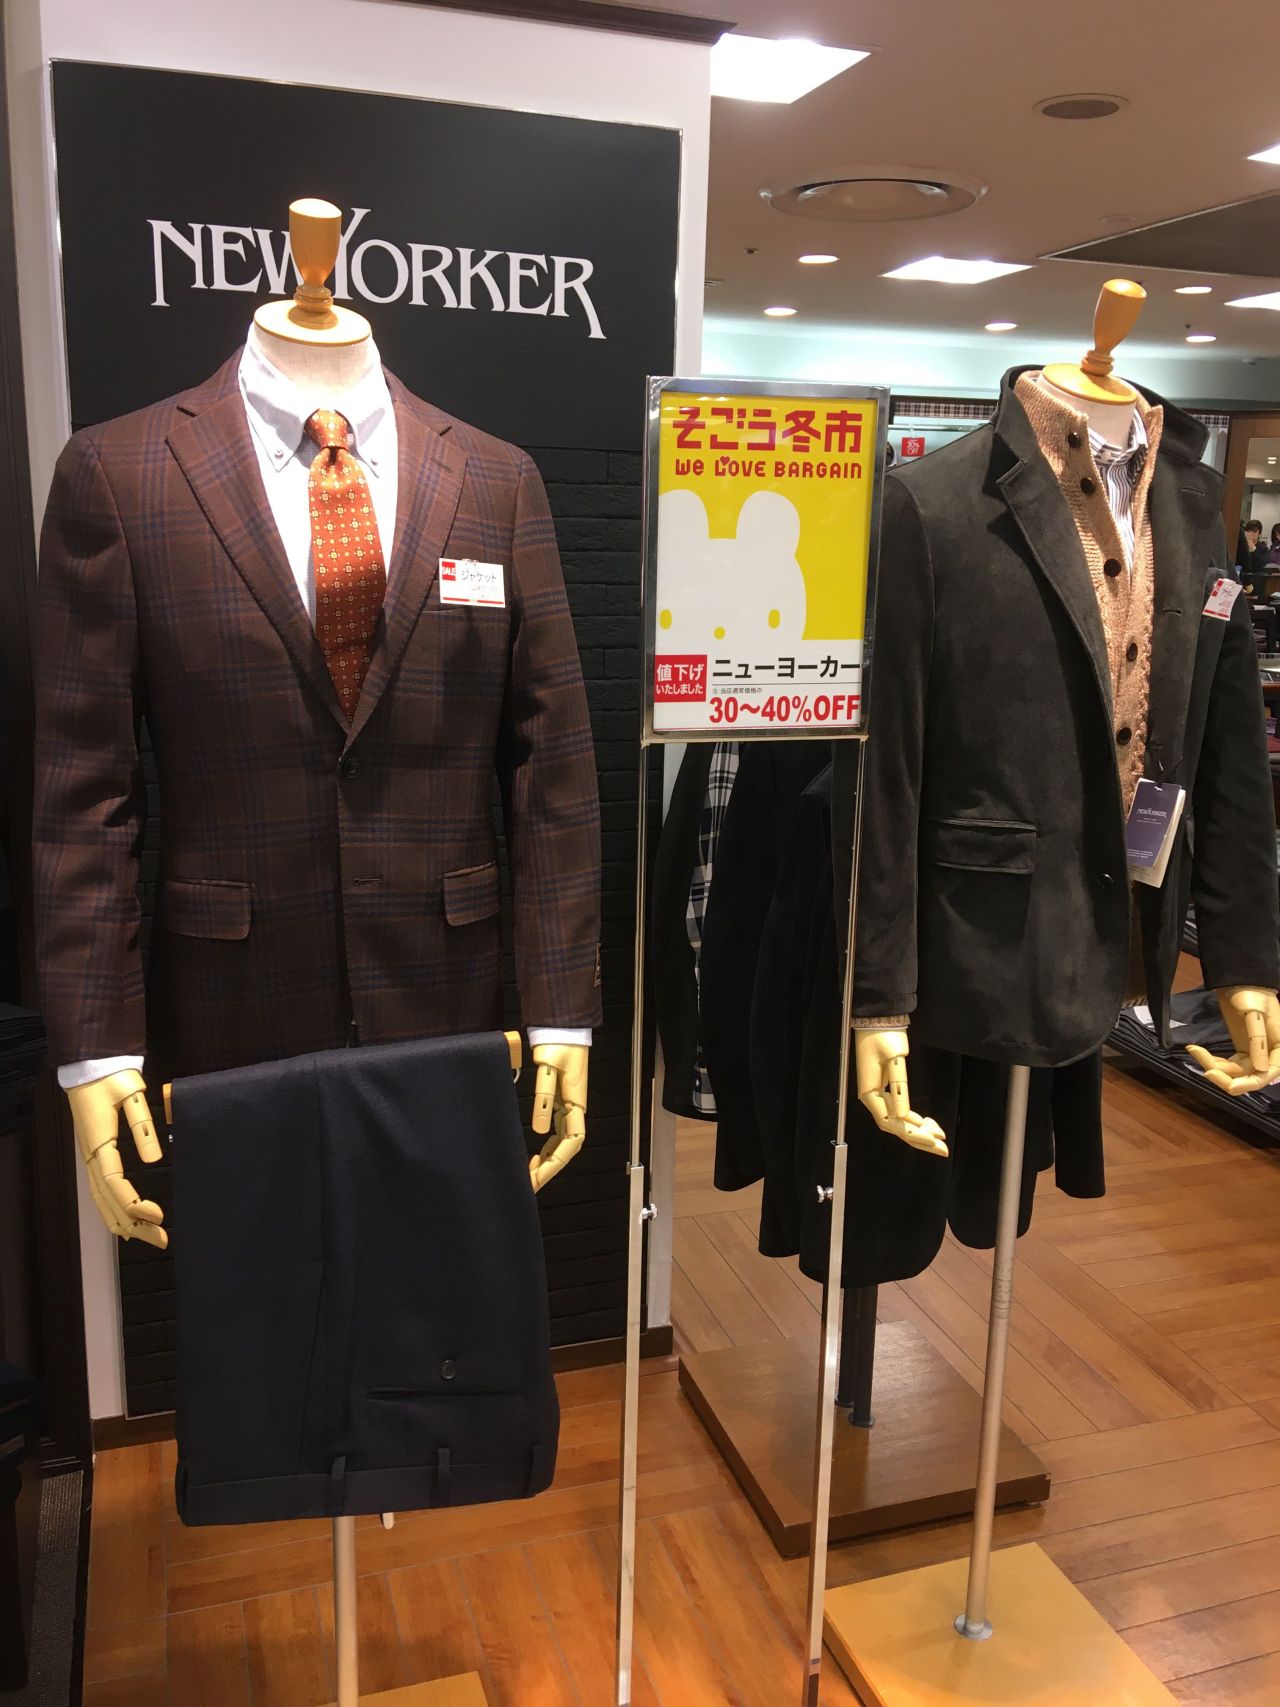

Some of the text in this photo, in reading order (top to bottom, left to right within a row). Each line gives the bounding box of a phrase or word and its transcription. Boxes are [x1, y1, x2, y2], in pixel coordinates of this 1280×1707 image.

[672, 406, 863, 453] そごう冬市
[714, 456, 766, 477] LOVE
[774, 461, 862, 479] BARGAIN
[656, 664, 704, 682] 値下げ
[712, 655, 861, 678] ニューヨーカー
[656, 683, 703, 695] いたしました
